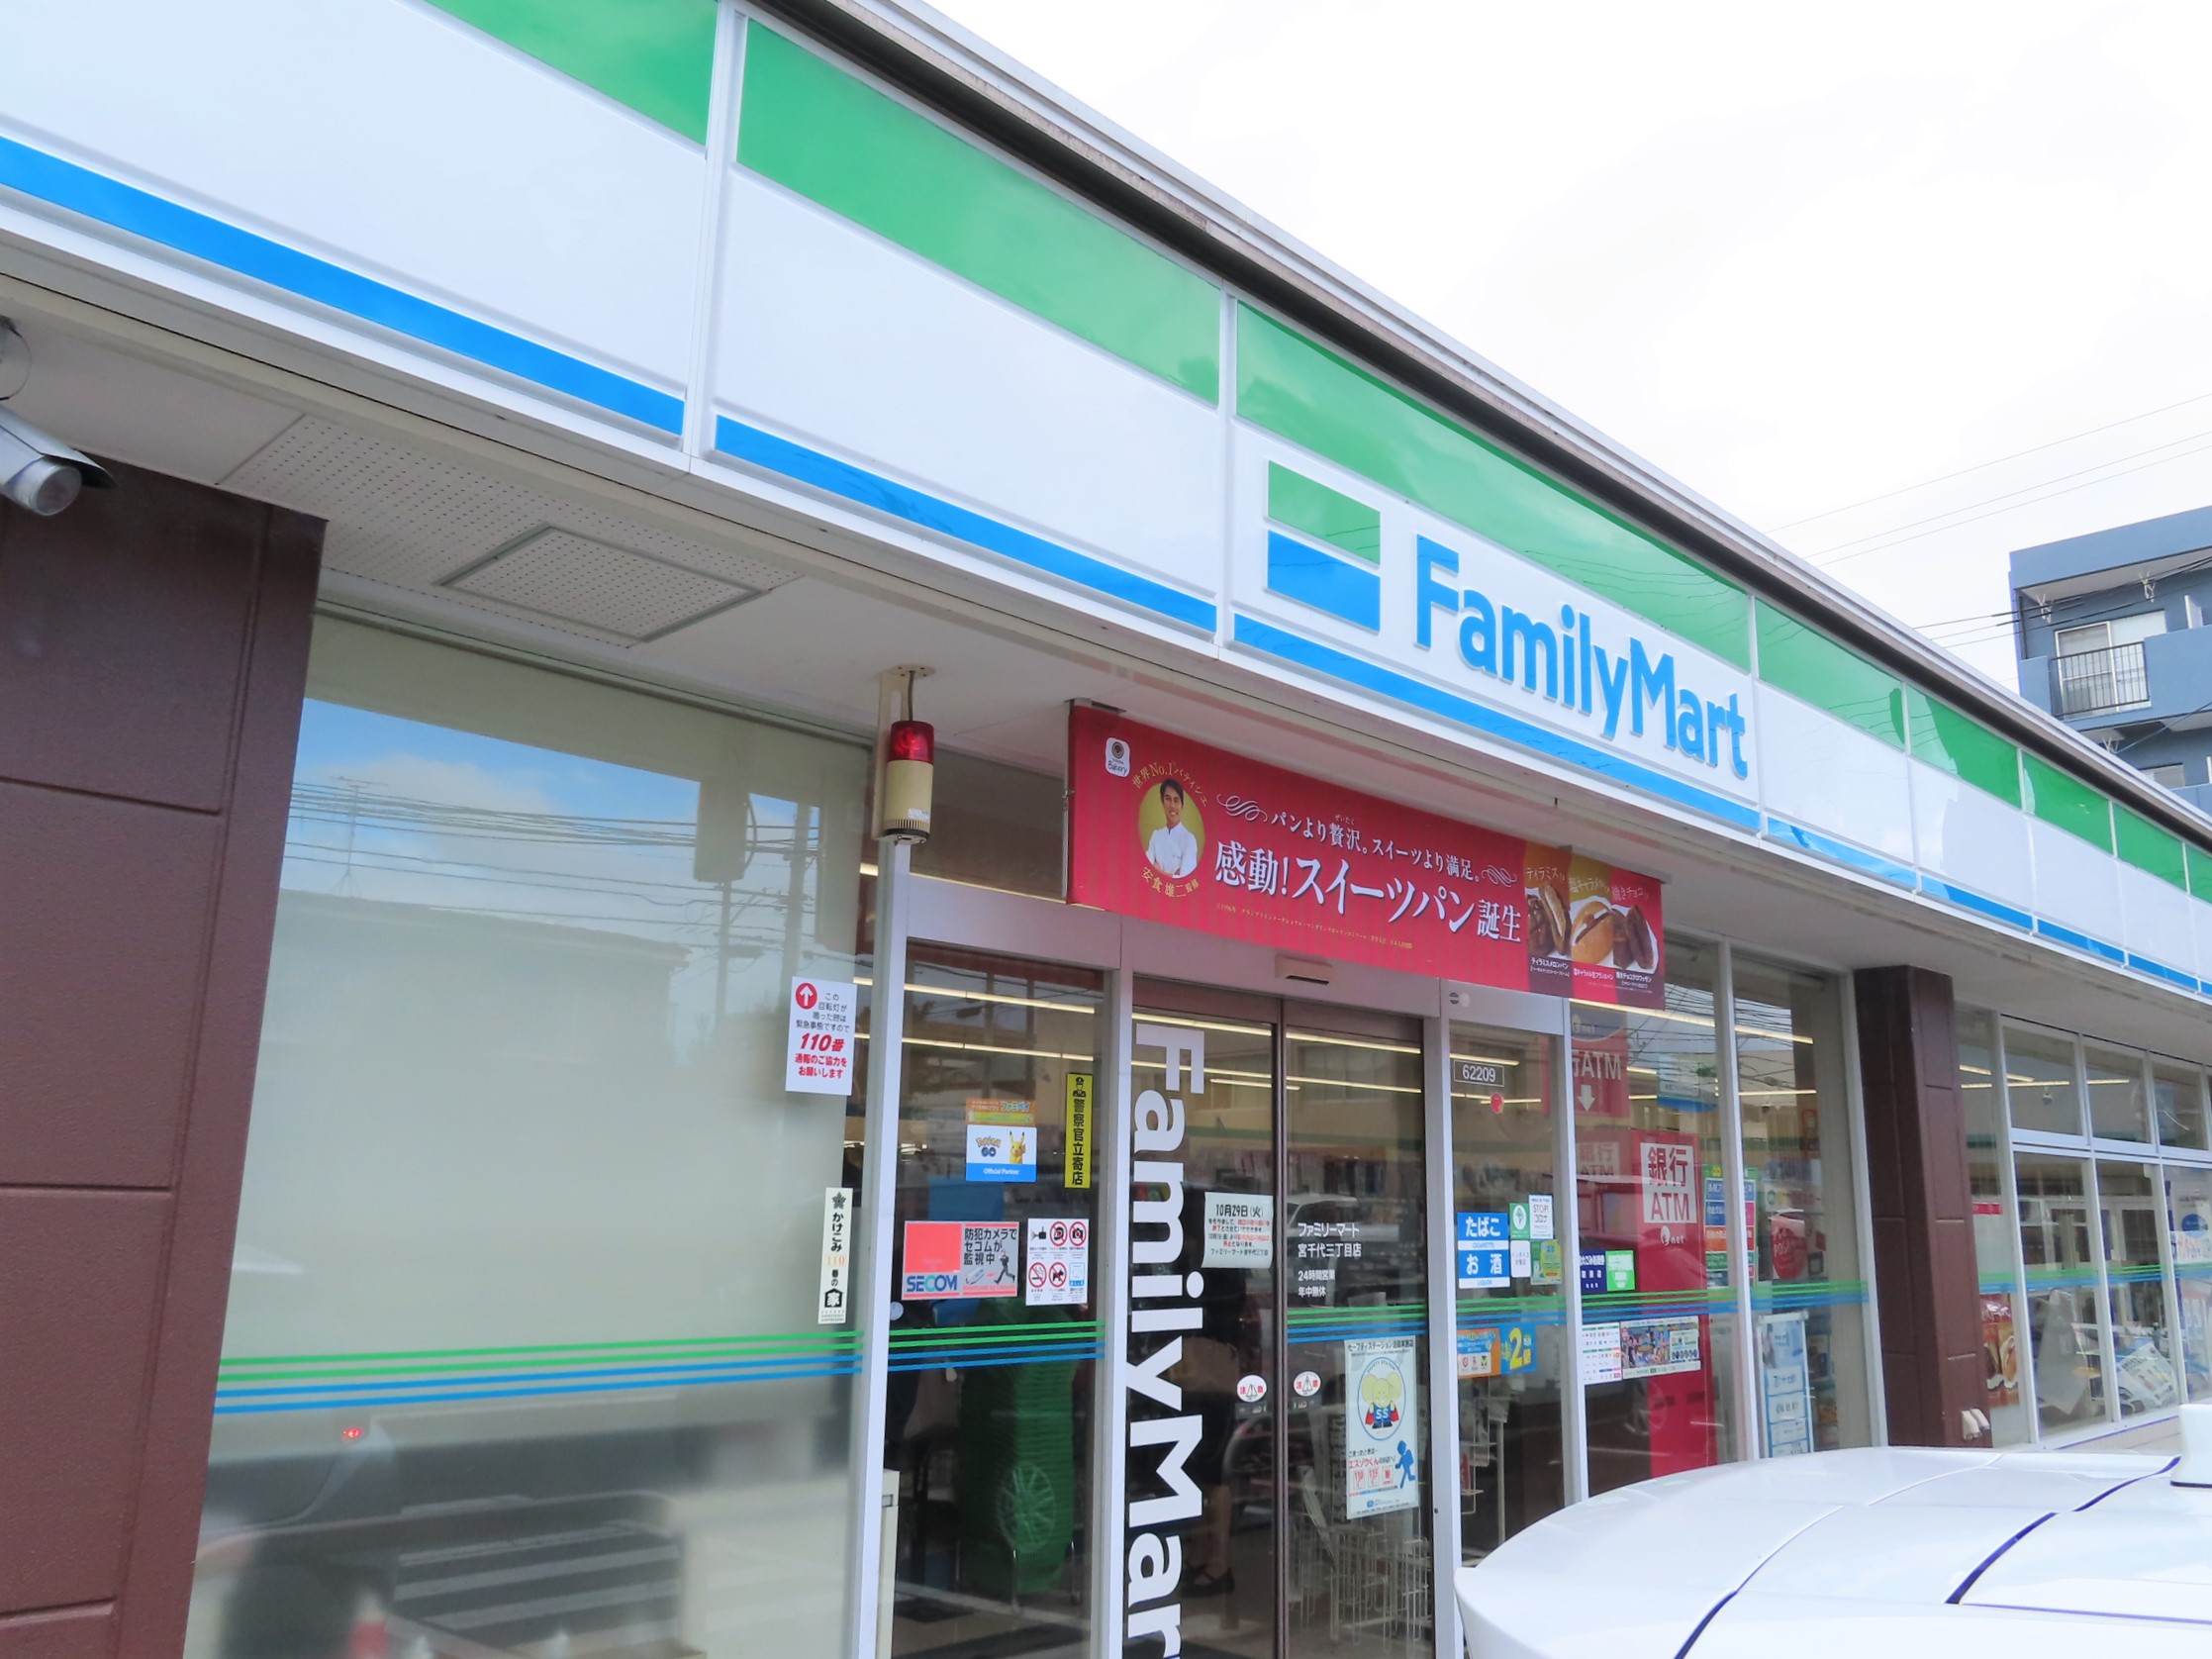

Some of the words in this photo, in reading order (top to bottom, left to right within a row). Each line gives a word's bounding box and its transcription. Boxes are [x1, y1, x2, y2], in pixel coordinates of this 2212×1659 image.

[1414, 534, 1749, 780] FamilyMart
[801, 1032, 844, 1052] 110番
[795, 1053, 847, 1067] 通報のご協力を
[799, 1066, 843, 1079] お願いします
[1463, 1064, 1495, 1083] 62209
[981, 1147, 997, 1157] GO
[1648, 1147, 1688, 1187] 銀行
[1651, 1193, 1689, 1221] ATM
[964, 1227, 1016, 1240] 防犯カメラで
[1298, 1222, 1359, 1238] ファミリーマート
[1466, 1217, 1500, 1237] たばこ
[965, 1240, 1003, 1252] セコムが
[1298, 1243, 1362, 1258] 宮千代三丁目店
[964, 1252, 995, 1265] 監視中
[1298, 1269, 1335, 1281] 24時間営業
[907, 1275, 958, 1292] SECOM
[1298, 1286, 1326, 1298] 年中無休
[1126, 1023, 1204, 1659] FamilyMar
[1376, 1409, 1390, 1419] SS
